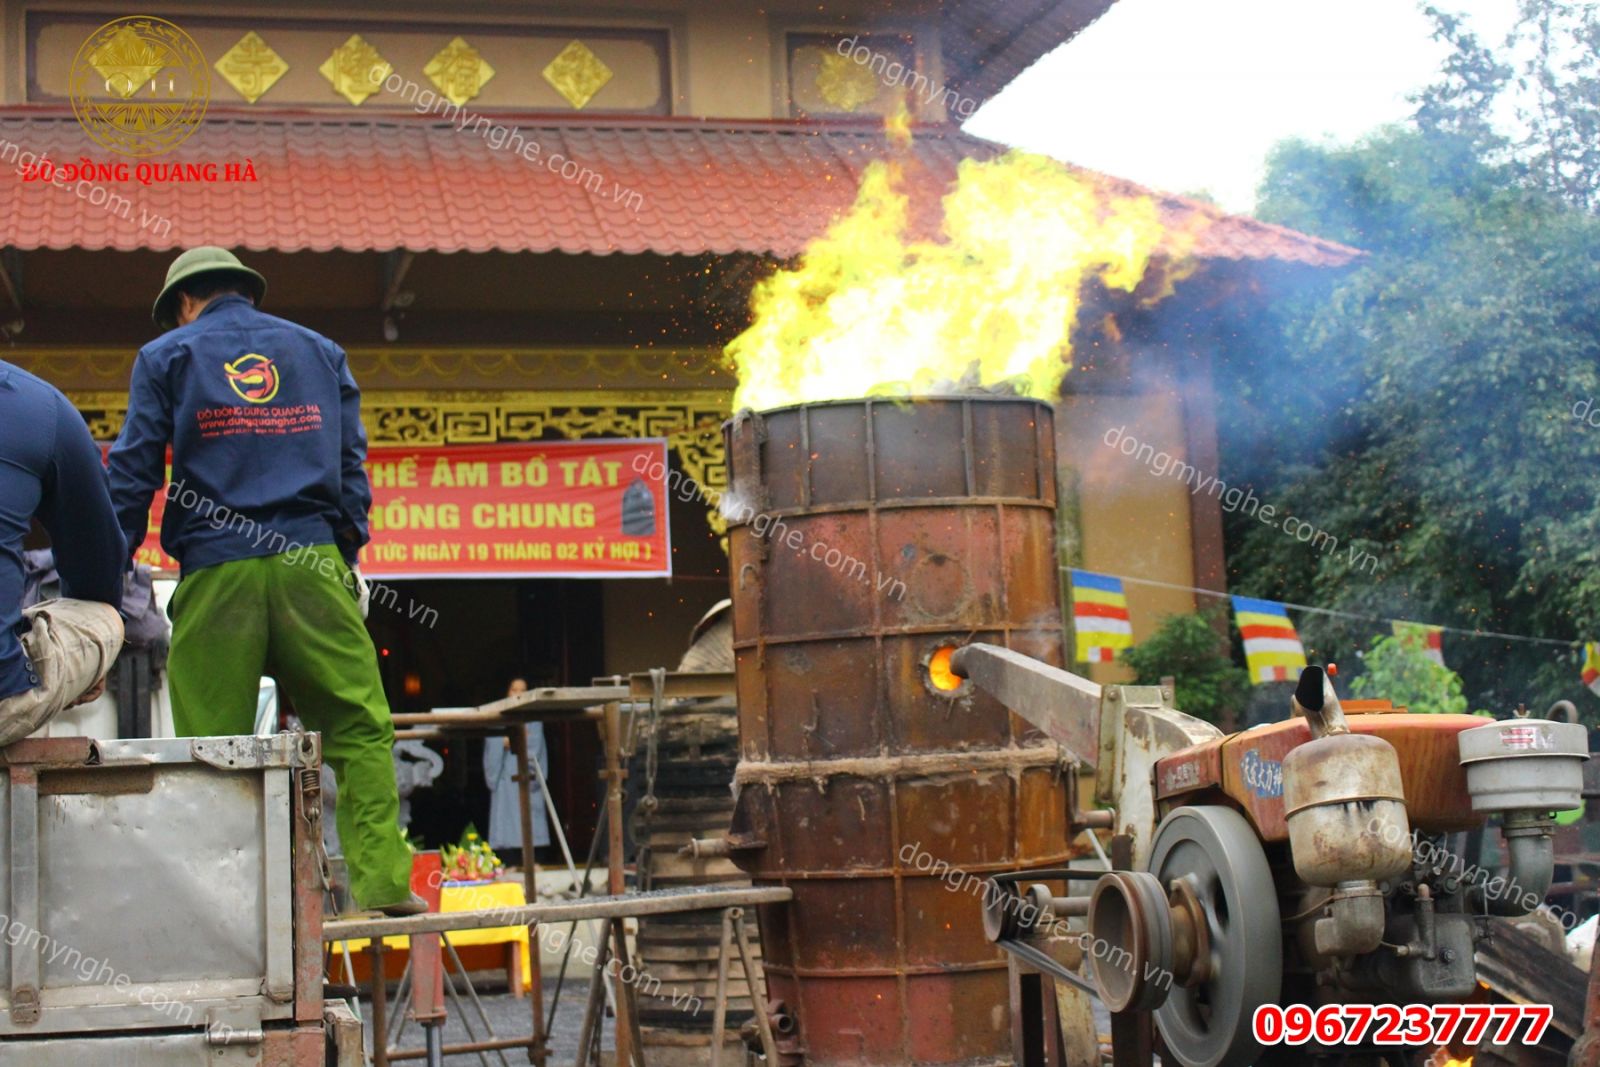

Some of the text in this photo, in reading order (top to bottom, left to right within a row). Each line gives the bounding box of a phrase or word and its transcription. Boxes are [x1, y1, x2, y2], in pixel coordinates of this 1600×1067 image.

[431, 456, 488, 488] ÂM
[560, 457, 622, 487] TÁT
[472, 502, 596, 529] CHUNG
[373, 540, 408, 562] TỨC
[413, 540, 461, 561] NGÀY
[467, 543, 489, 560] 19
[493, 540, 552, 560] THÁNG
[557, 542, 579, 560] 02
